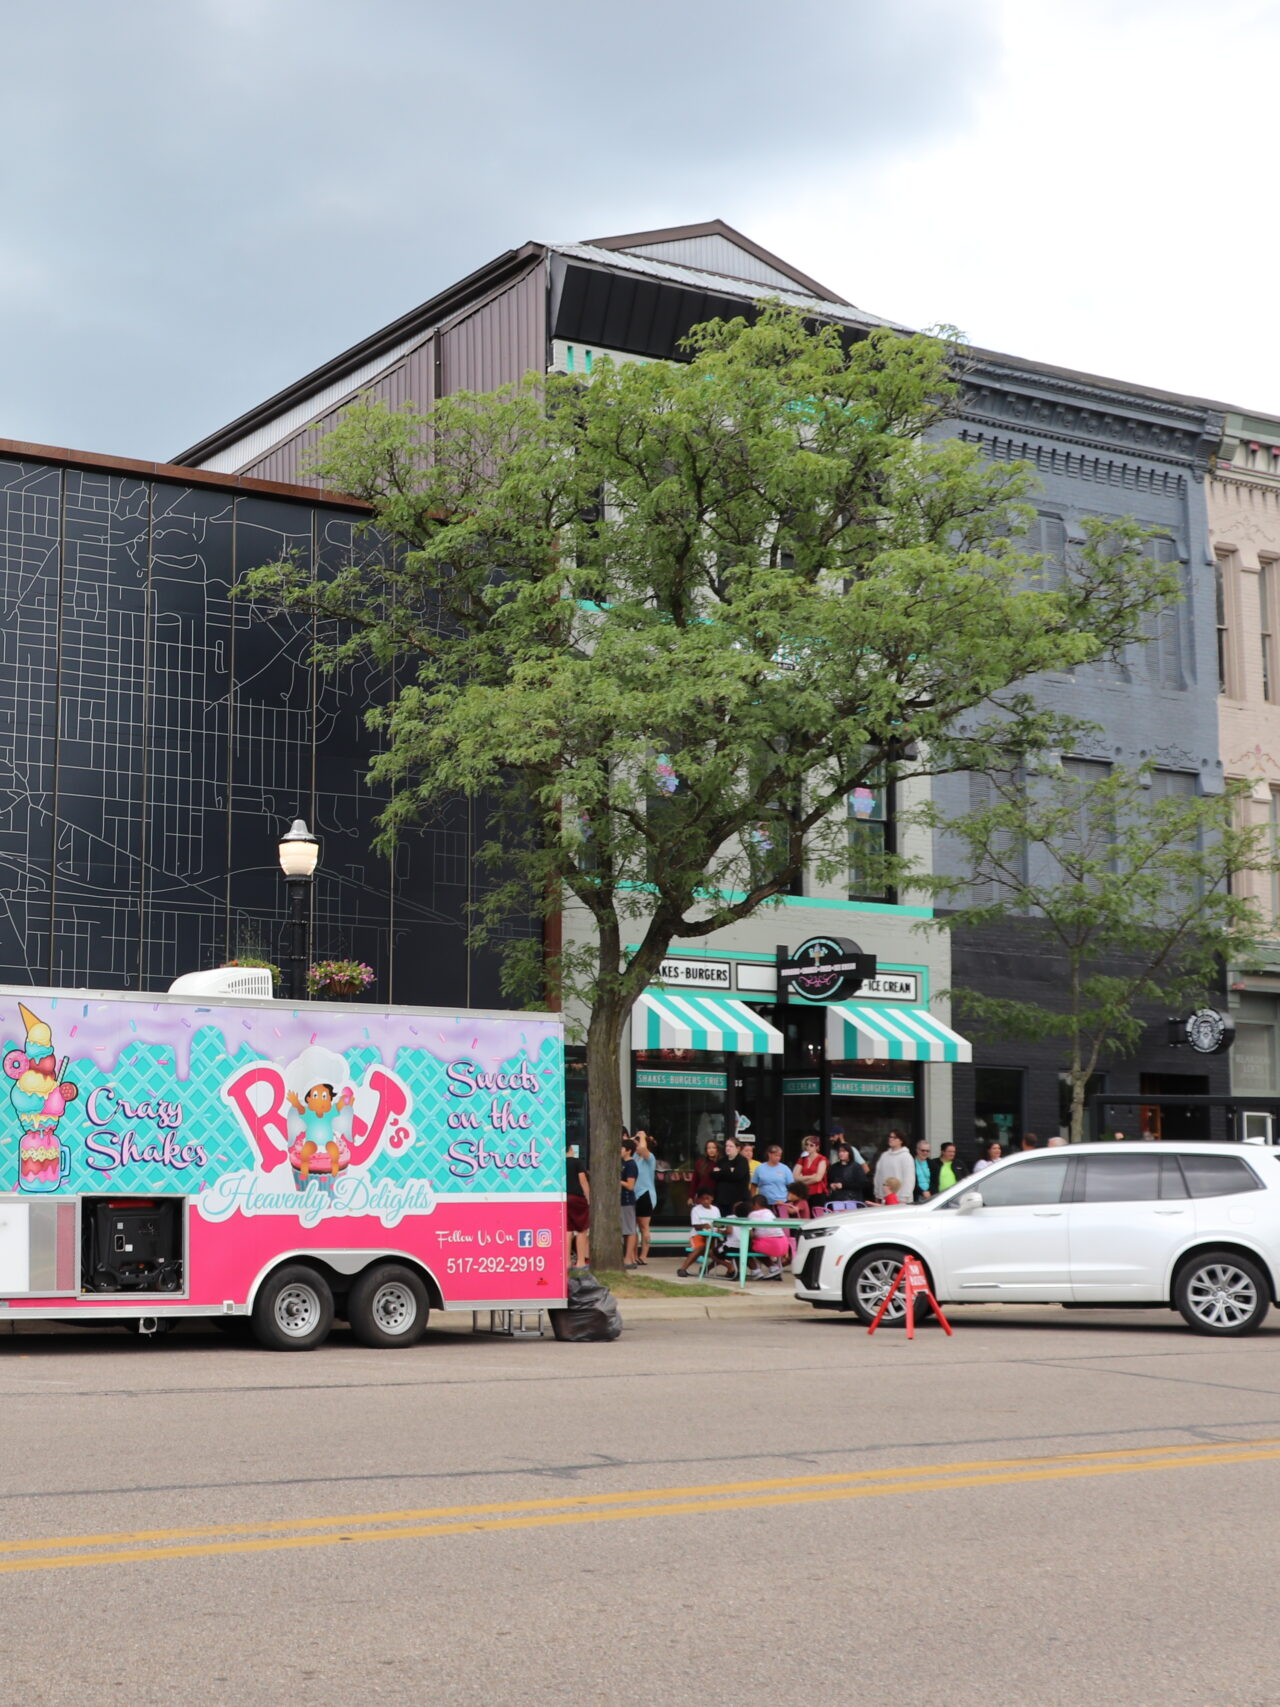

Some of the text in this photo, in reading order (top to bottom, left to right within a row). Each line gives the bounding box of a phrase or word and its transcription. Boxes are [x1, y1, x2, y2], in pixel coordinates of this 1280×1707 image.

[653, 966, 728, 981] AKES-BURGERS
[883, 981, 911, 993] CREAM
[447, 1060, 539, 1098] Sweets
[86, 1086, 183, 1128] Crazy
[447, 1098, 535, 1133] on the
[85, 1129, 208, 1170] Shakes
[448, 1137, 542, 1177] Street
[203, 1175, 433, 1221] Heavenly Delights
[435, 1230, 473, 1249] Follow
[477, 1229, 491, 1246] Us
[495, 1229, 514, 1244] On
[447, 1256, 545, 1274] 517-292-2919
